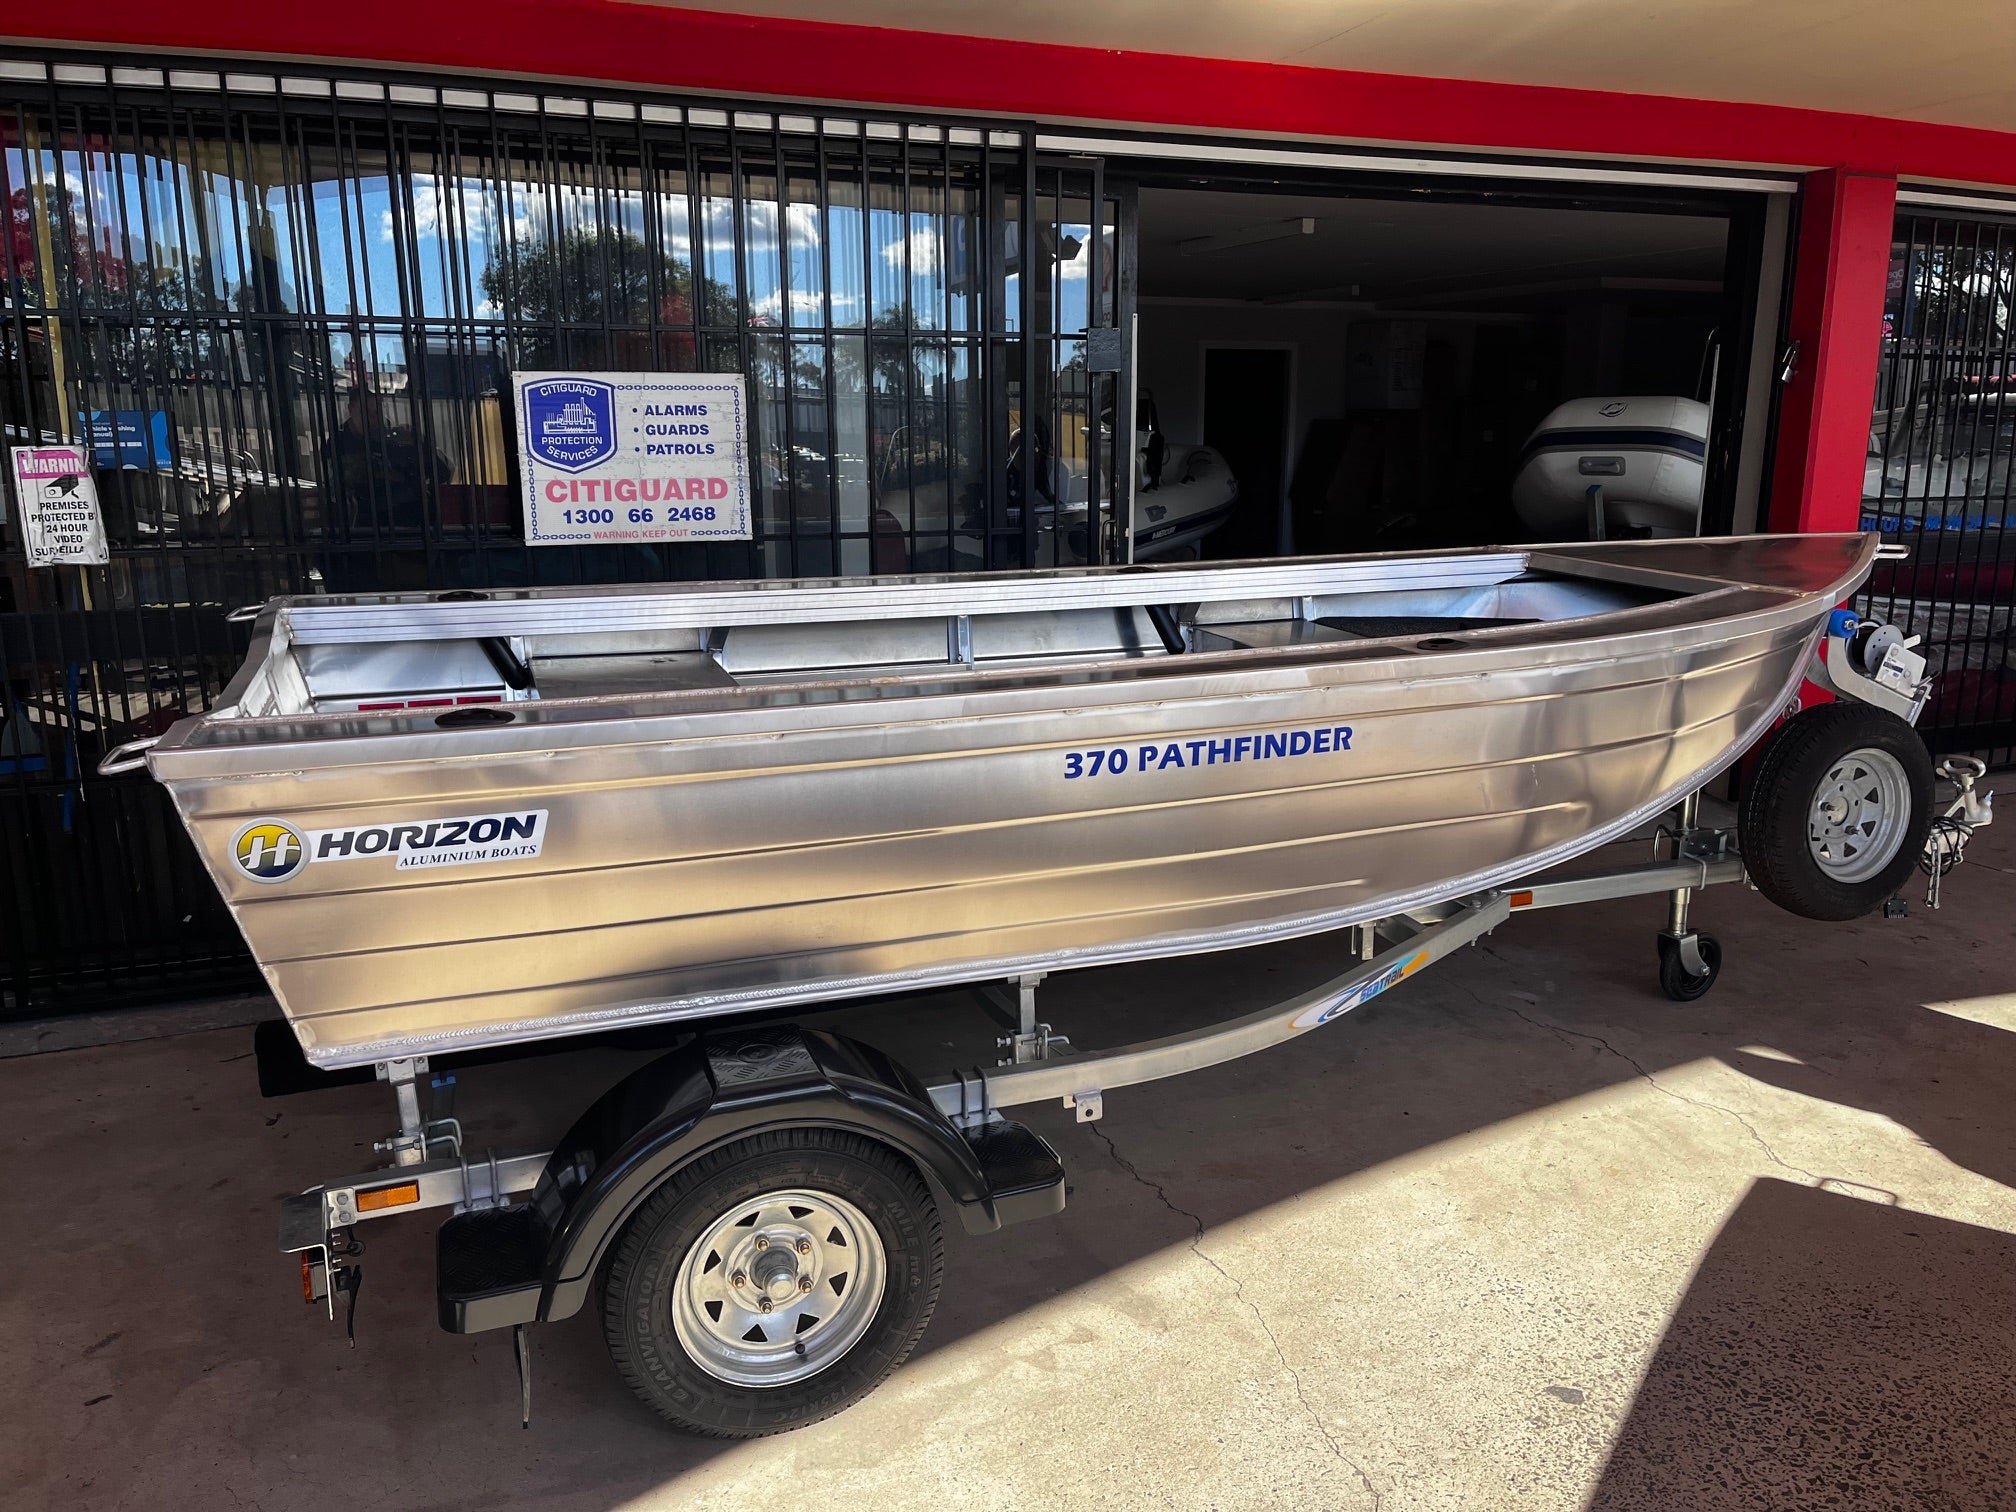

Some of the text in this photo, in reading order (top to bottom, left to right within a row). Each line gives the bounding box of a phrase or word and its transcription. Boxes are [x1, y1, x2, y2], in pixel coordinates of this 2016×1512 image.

[540, 383, 597, 397] CITIGUARD
[644, 405, 708, 416] ALARMS
[645, 424, 710, 436] GUARDS
[541, 436, 603, 445] PROTECTION
[546, 445, 599, 461] SERVICES
[646, 443, 715, 455] PATROLS
[22, 457, 85, 473] WARNIN
[545, 477, 729, 503] CITIGUARD
[39, 500, 89, 511] PREMISES
[31, 512, 95, 523] PROTECTED B
[563, 506, 716, 524] 1300 66 2468
[46, 523, 89, 534] 24 HOUR
[593, 529, 689, 540] WARNING KEEP OUT
[53, 534, 83, 543] VIDEO
[1064, 726, 1354, 779] 370 PATHFINDER
[317, 814, 538, 858] HORIZON
[400, 844, 537, 867] ALUMINIUM BOATS
